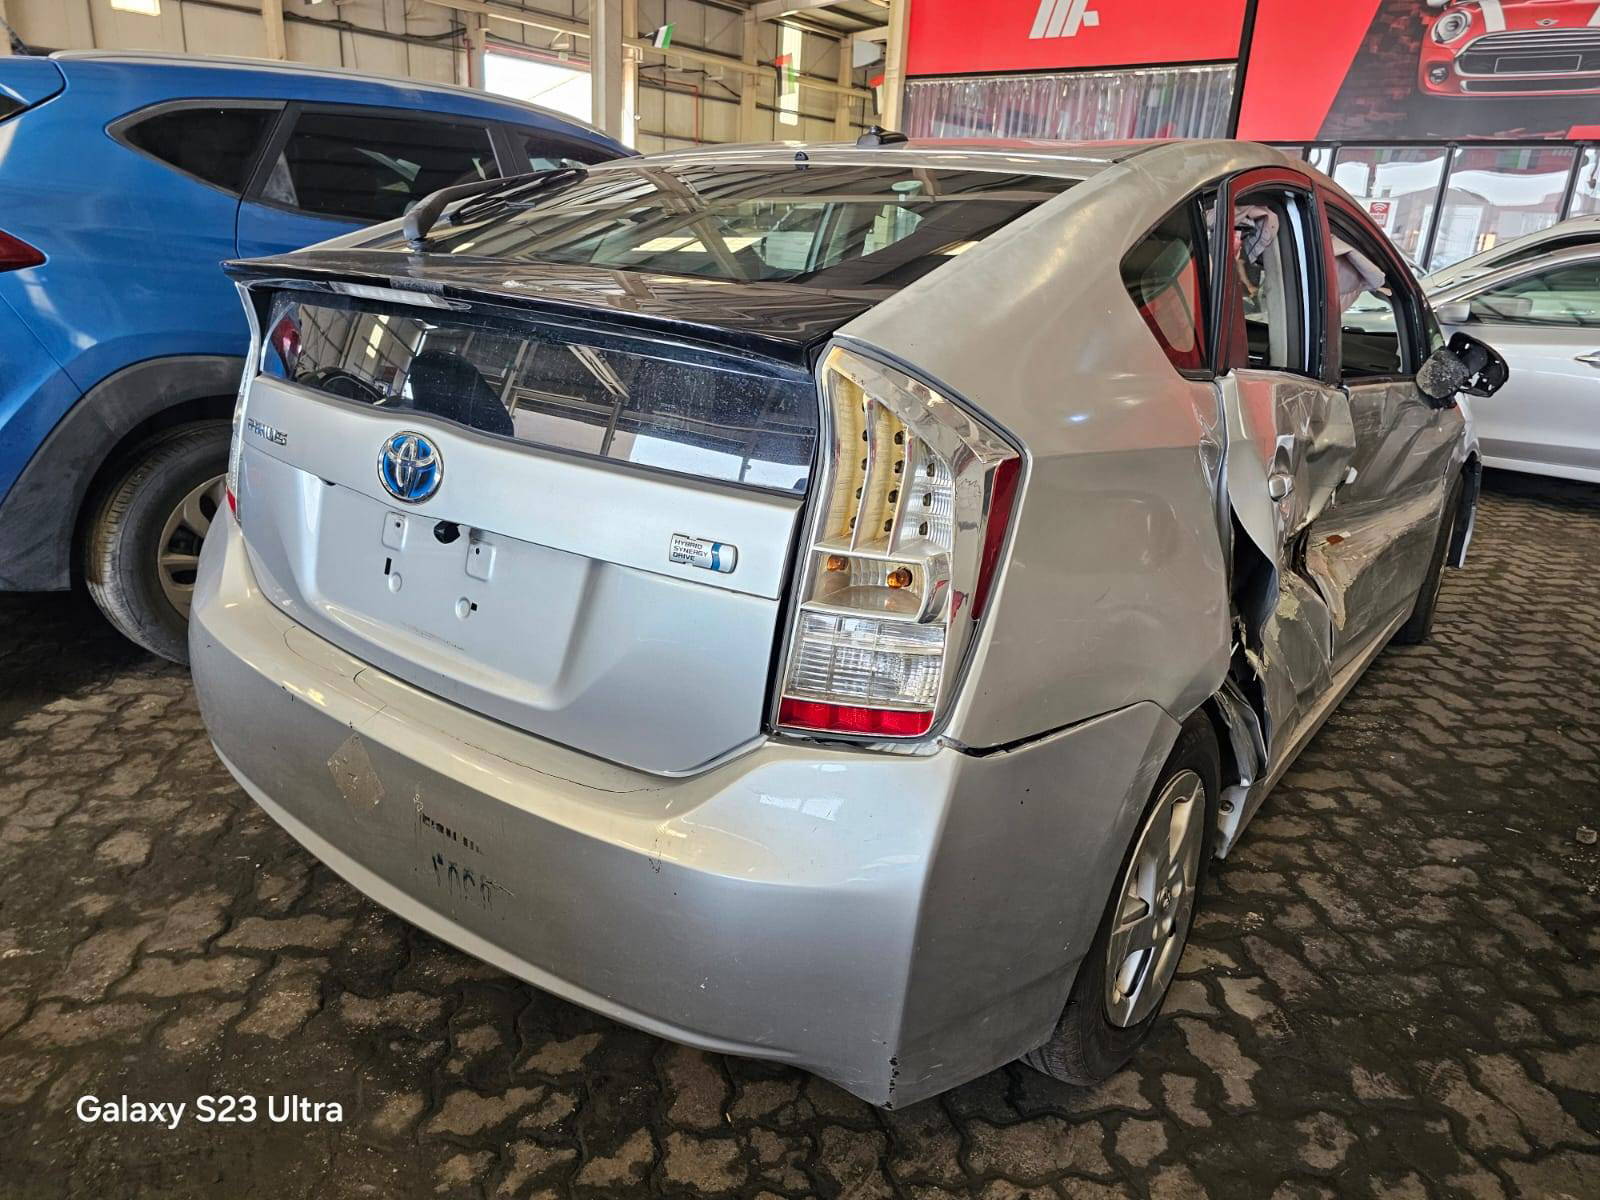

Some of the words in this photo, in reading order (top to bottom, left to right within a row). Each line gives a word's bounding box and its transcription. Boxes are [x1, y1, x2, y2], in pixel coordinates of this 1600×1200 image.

[674, 539, 703, 550] HYBRID
[672, 551, 695, 562] DRIVE
[673, 545, 708, 558] SYNERGY
